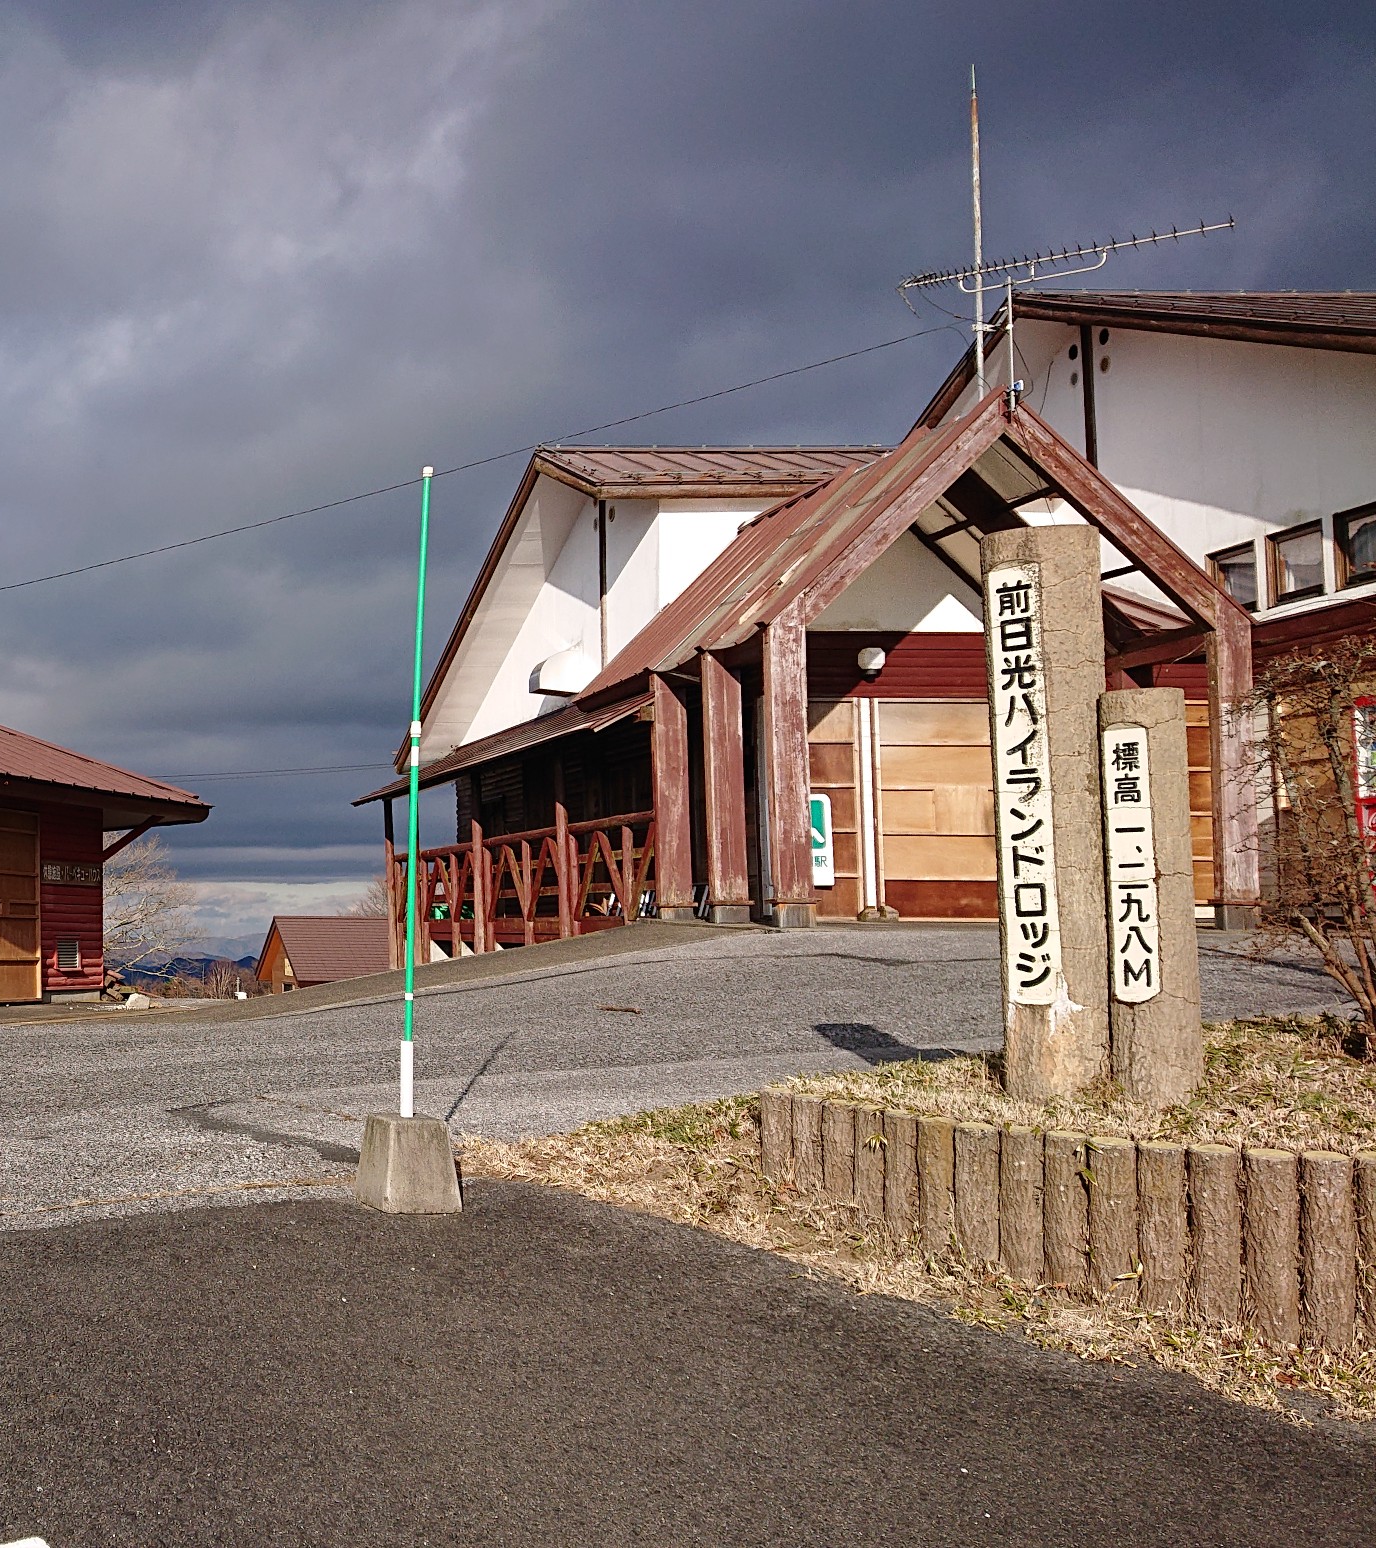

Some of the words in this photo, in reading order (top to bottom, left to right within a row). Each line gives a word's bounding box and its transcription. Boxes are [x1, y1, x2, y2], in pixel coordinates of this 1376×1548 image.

[995, 579, 1052, 988] 前日光ハイランドロッジ
